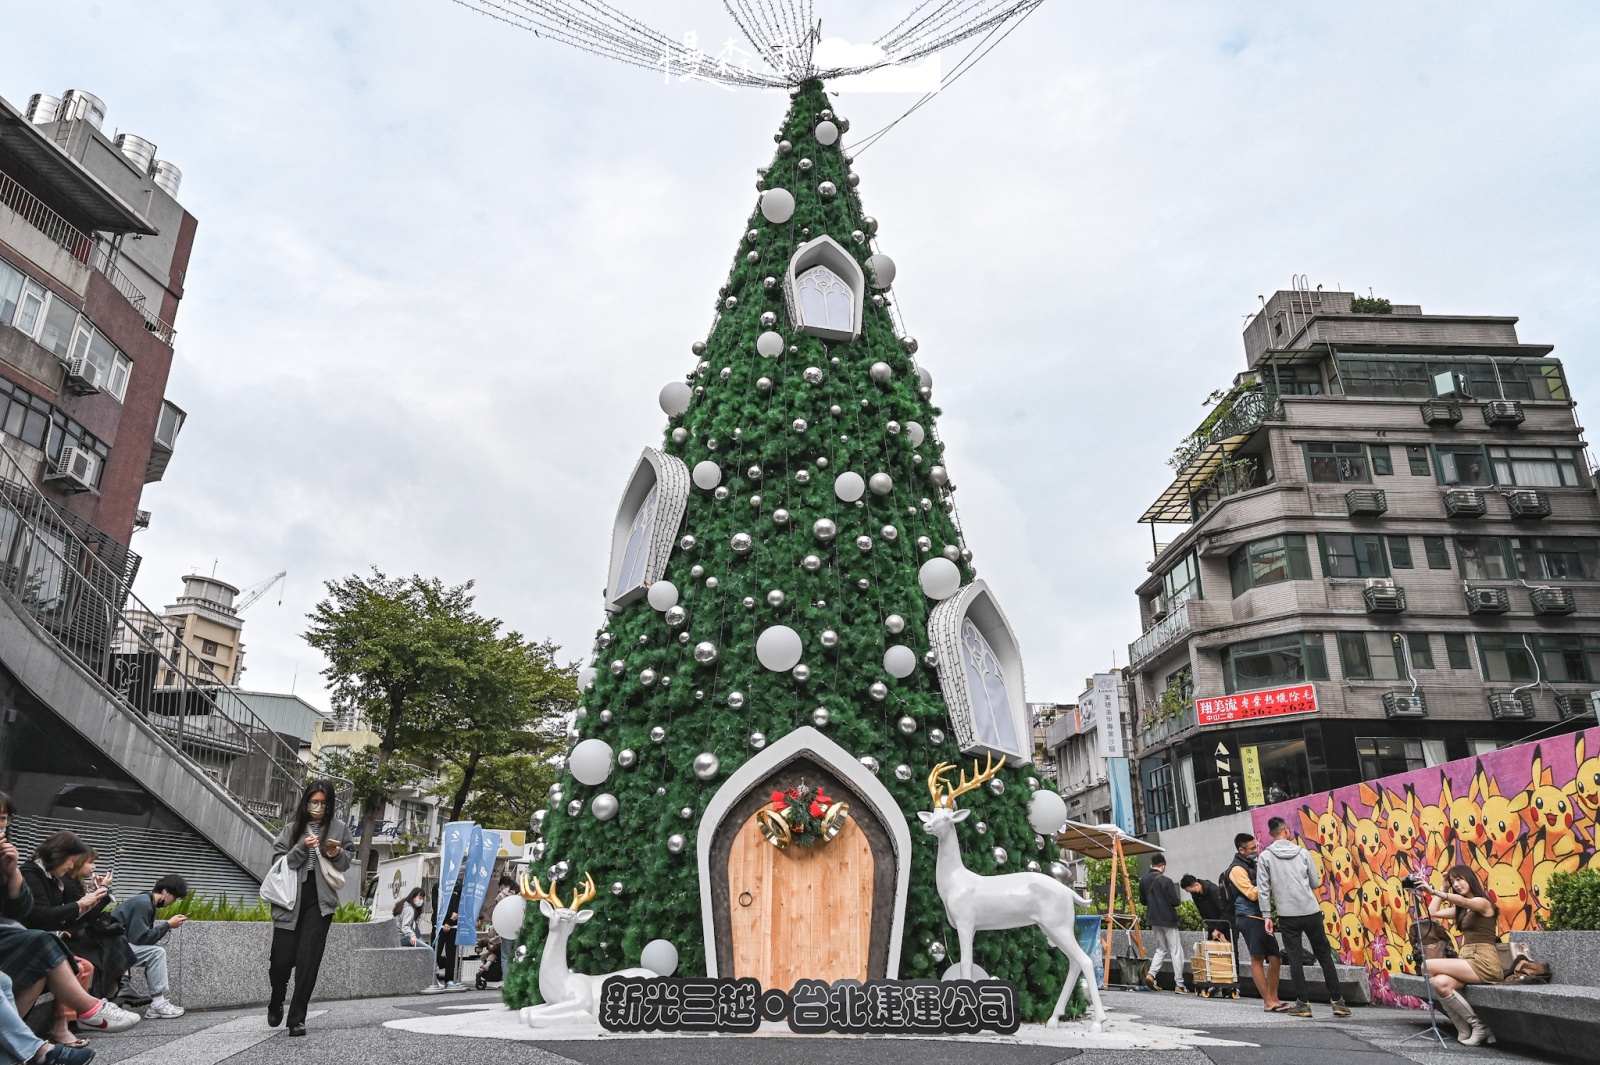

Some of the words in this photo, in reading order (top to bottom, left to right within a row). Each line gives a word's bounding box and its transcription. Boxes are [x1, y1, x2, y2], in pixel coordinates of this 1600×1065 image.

[1241, 701, 1313, 718] 2567-7627
[1214, 741, 1231, 806] ANTI
[1233, 782, 1242, 811] SALON
